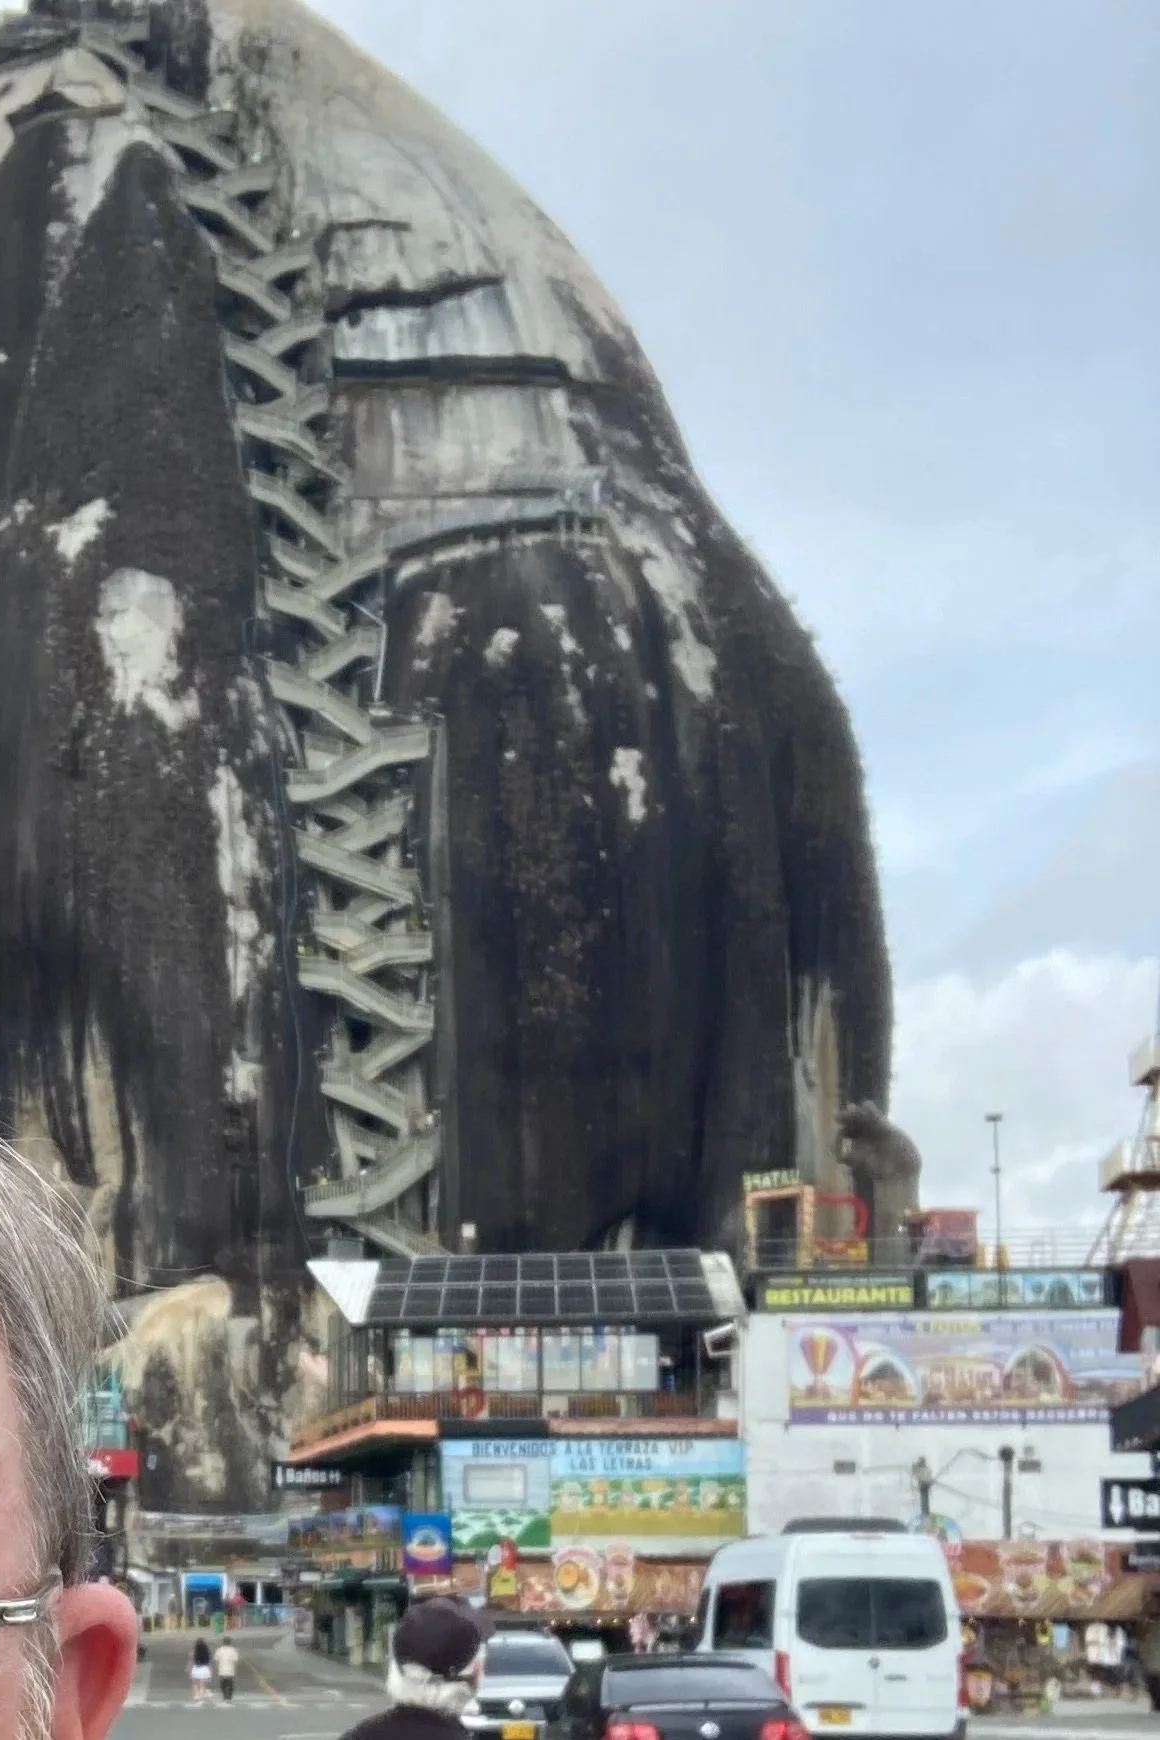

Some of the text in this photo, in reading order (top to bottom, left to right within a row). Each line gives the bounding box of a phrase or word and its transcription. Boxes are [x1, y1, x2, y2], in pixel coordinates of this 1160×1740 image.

[765, 1286, 913, 1305] RESTAURANTE
[1026, 1408, 1109, 1420] RECUERDO
[472, 1440, 695, 1457] BIENVENIDOS A LA TERRAZA VIP
[570, 1457, 653, 1471] LAS LETRAS
[286, 1467, 327, 1483] Baños
[1128, 1488, 1160, 1517] Ba
